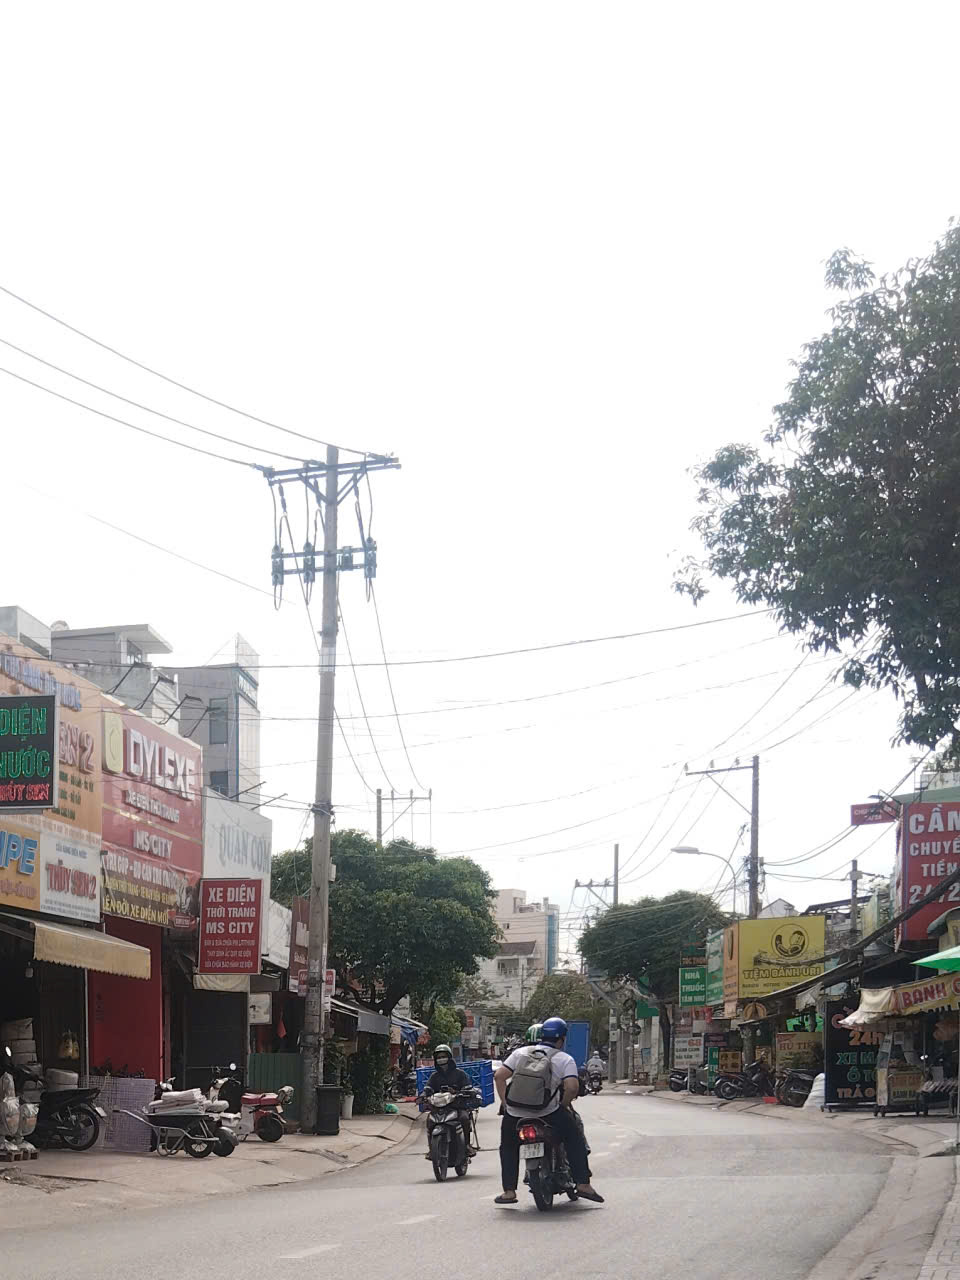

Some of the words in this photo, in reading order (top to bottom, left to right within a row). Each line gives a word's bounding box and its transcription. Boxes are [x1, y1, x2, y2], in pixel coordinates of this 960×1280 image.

[149, 833, 173, 860] CITY
[208, 887, 224, 903] XE
[227, 884, 256, 906] ĐIỆN
[130, 903, 140, 918] XE
[206, 904, 226, 918] THỜI
[228, 907, 256, 918] TRANG
[206, 922, 225, 934] MS
[228, 922, 254, 934] CITY
[685, 970, 700, 980] NHÀ
[743, 966, 770, 982] TIỆM
[771, 967, 801, 979] BÁNH
[682, 981, 705, 992] THUỐC
[836, 1052, 857, 1065] XE
[837, 1084, 864, 1098] TRẢ
